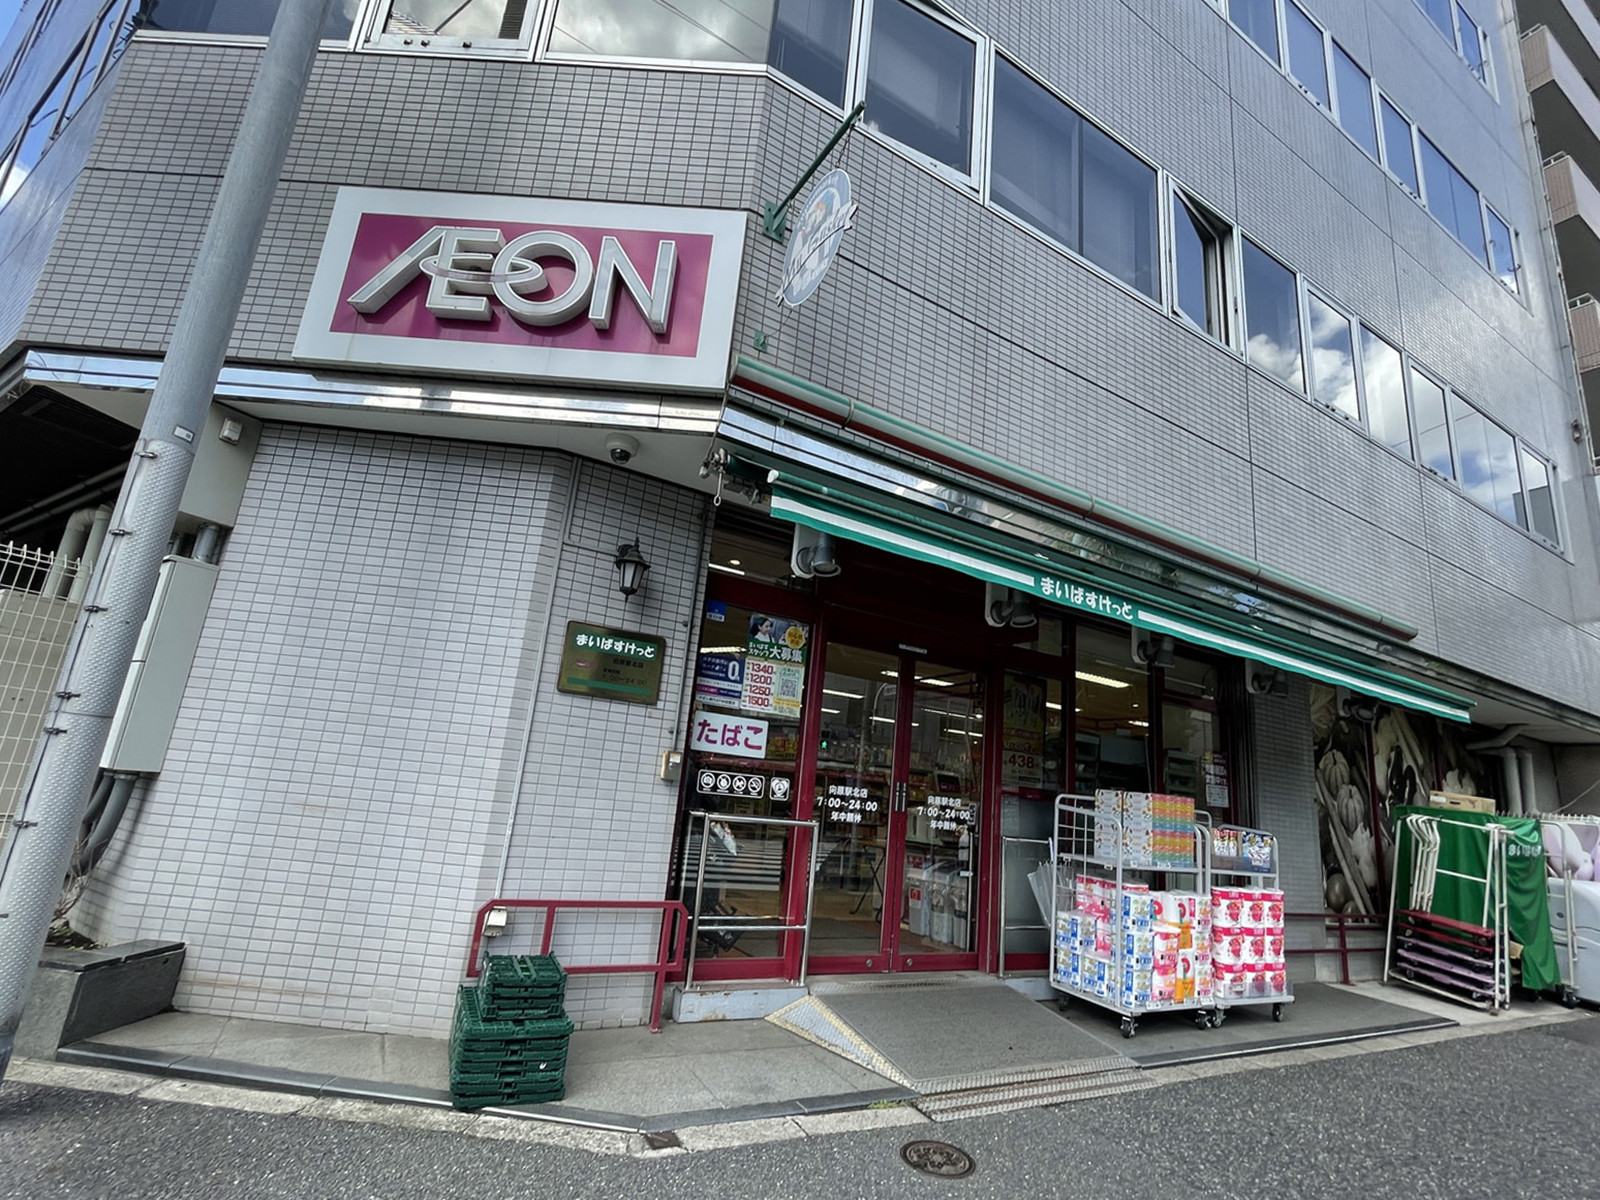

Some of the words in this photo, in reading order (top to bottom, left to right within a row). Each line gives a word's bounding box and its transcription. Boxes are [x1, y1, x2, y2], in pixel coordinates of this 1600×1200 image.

[346, 224, 677, 334] AEON
[1040, 577, 1134, 620] まいばすけっと
[576, 633, 655, 658] まいばすけっと
[751, 662, 774, 675] 1340
[750, 673, 773, 685] 1200
[748, 684, 771, 696] 1250
[747, 695, 770, 707] 1500
[696, 719, 763, 751] たばこ
[1008, 754, 1034, 769] 438
